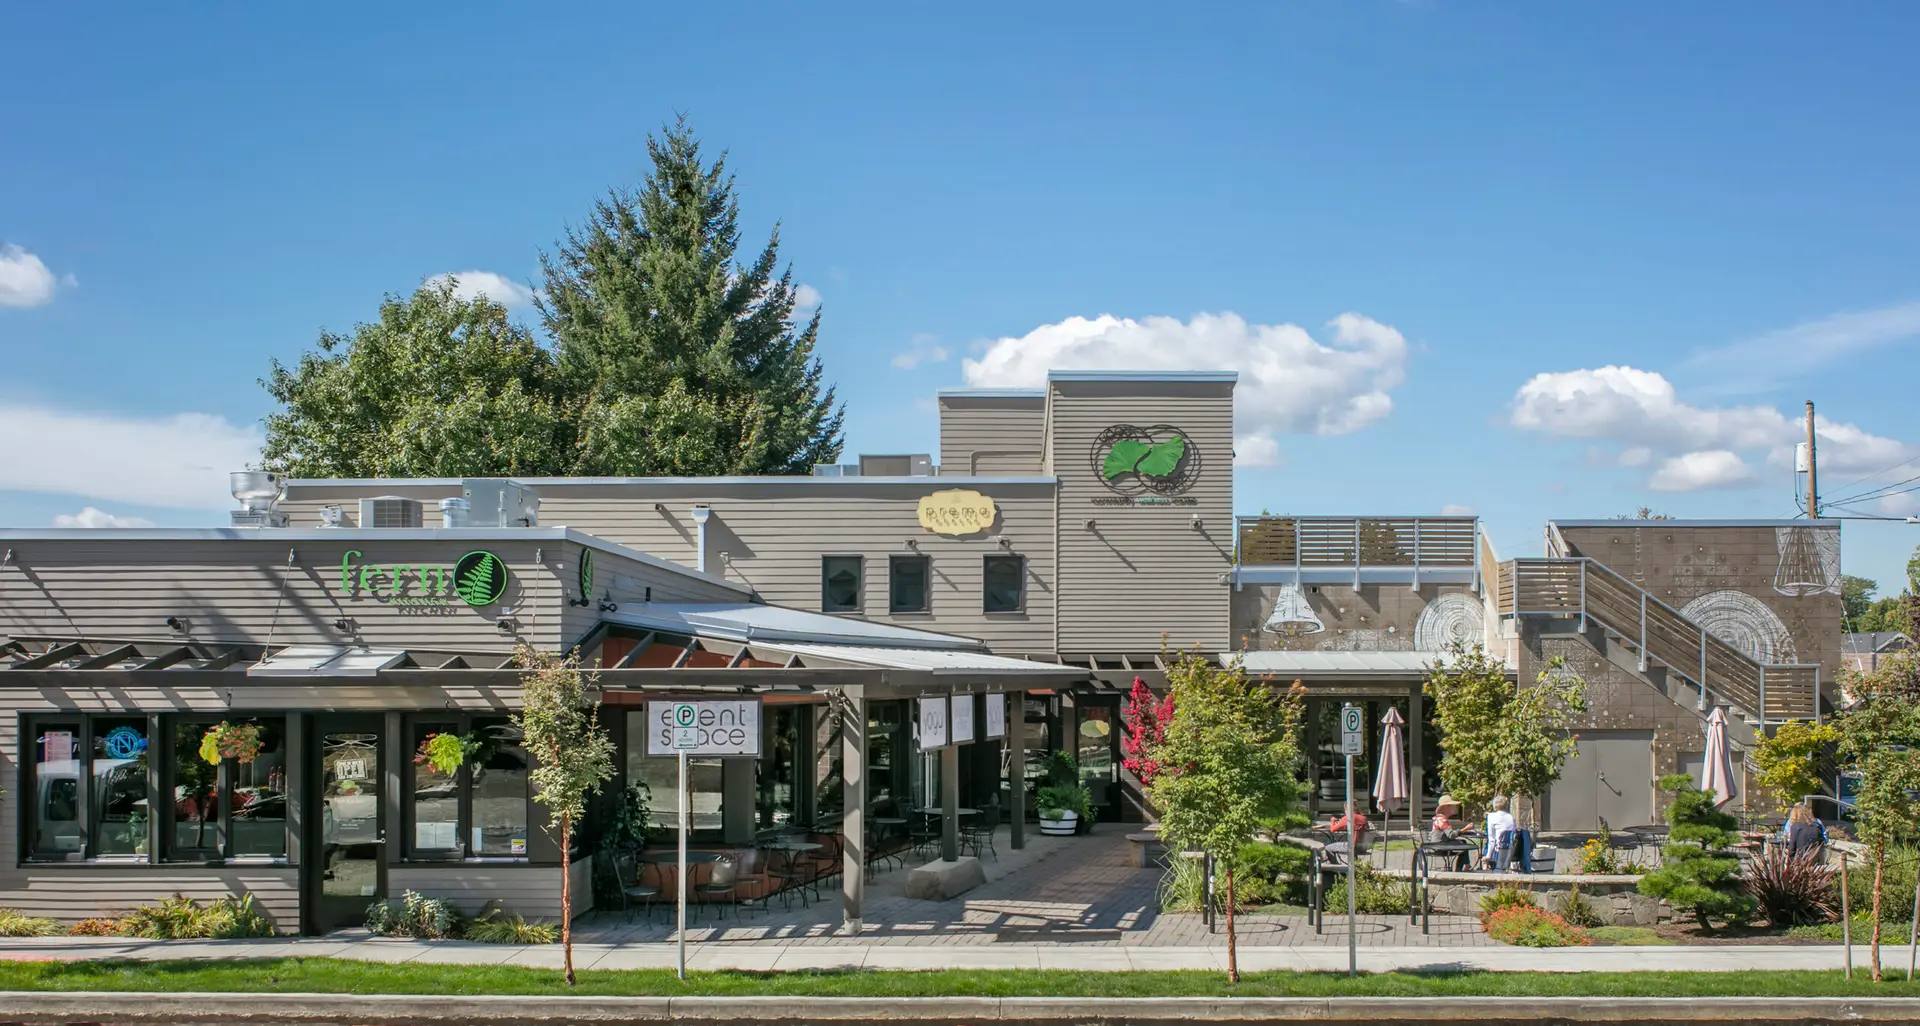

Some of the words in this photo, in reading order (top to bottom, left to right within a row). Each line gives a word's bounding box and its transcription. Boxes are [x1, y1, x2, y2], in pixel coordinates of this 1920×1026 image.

[339, 550, 445, 591] fern
[661, 704, 746, 726] eent
[682, 709, 691, 722] P
[1350, 714, 1356, 727] P
[661, 728, 746, 746] sace
[683, 729, 689, 737] 2
